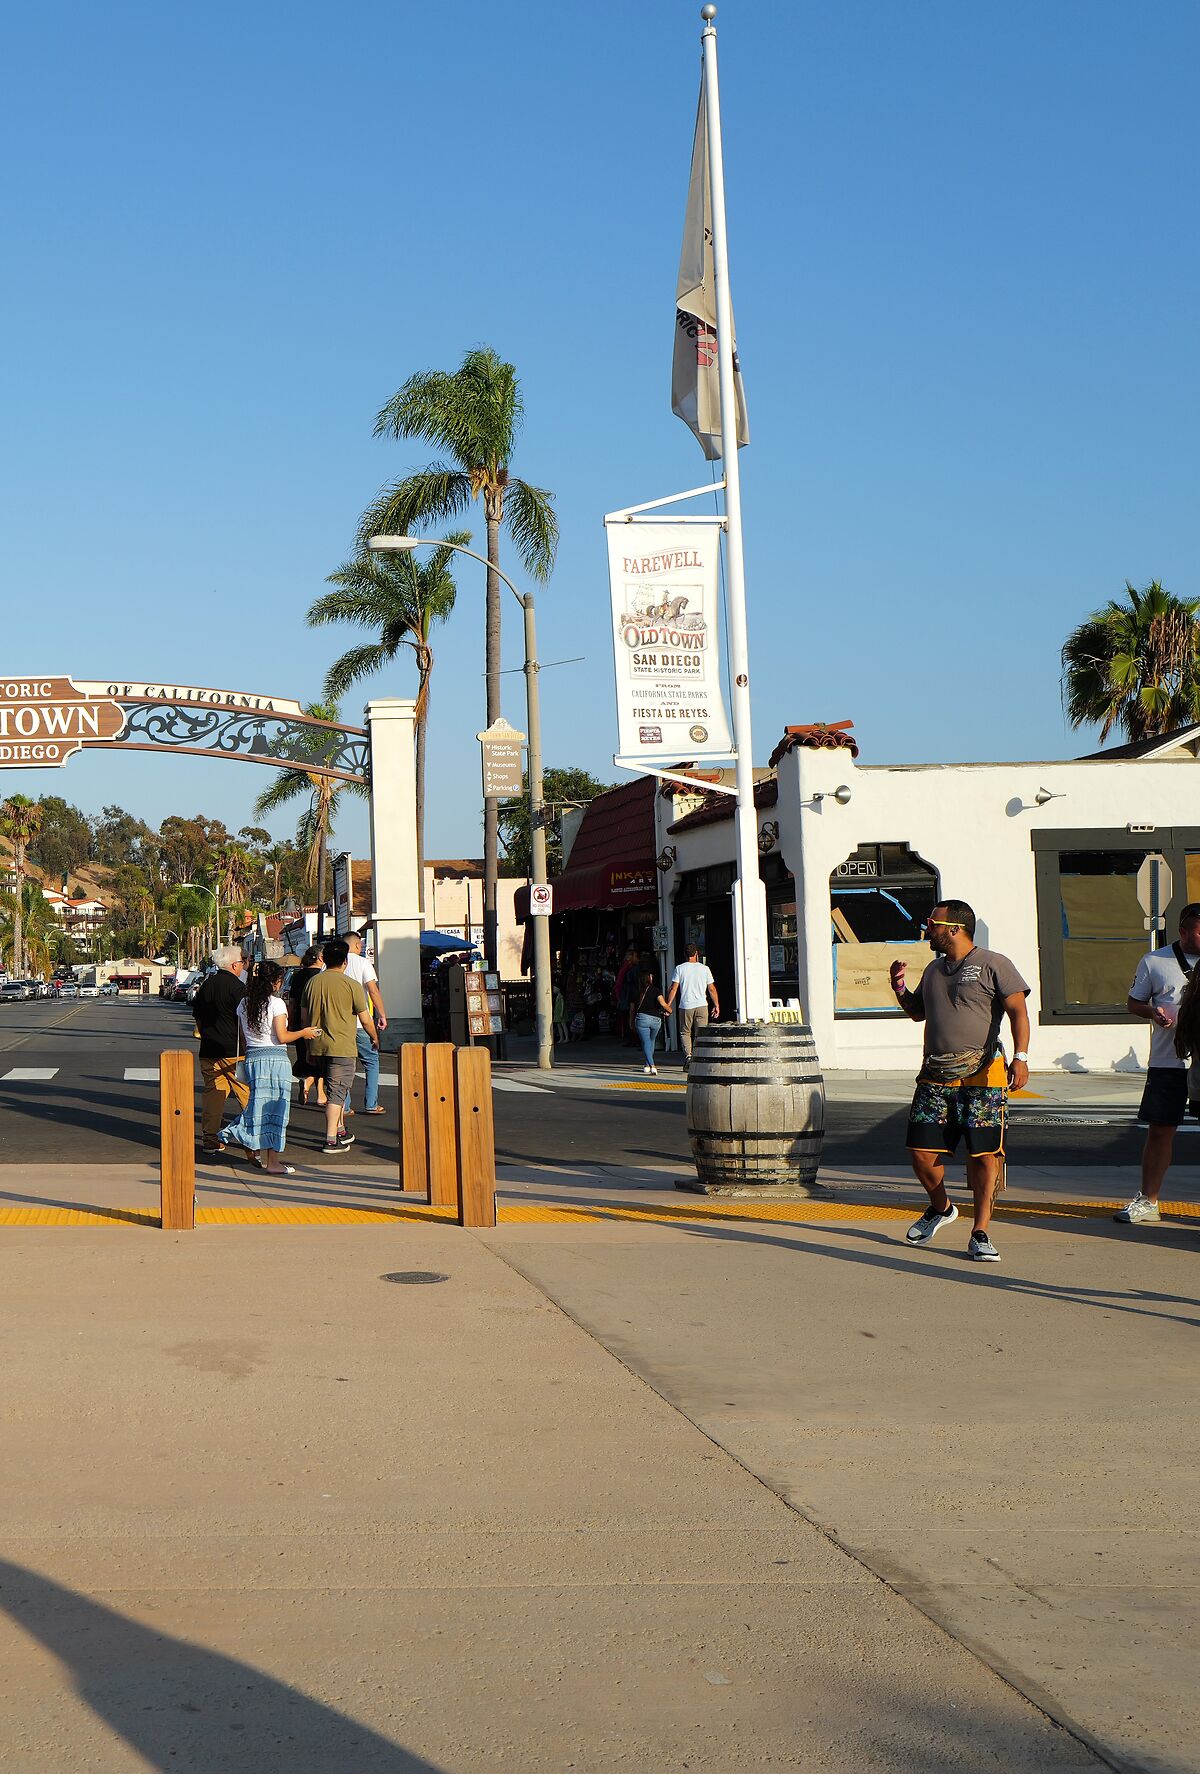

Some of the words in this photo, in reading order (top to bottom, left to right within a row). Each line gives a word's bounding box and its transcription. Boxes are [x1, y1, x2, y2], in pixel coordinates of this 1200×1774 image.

[623, 626, 659, 648] OLD
[659, 627, 705, 649] TOWN
[633, 654, 657, 665] SAN
[661, 655, 701, 667] DIEGO
[106, 684, 133, 697] OF
[144, 686, 276, 712] CALIFORNIA
[631, 690, 667, 698] CALIFORNIA
[668, 691, 687, 699] STATE
[688, 691, 708, 699] PARKS
[633, 709, 663, 718] FIESTA
[665, 709, 677, 718] DE
[0, 745, 60, 760] DIEGO
[839, 862, 876, 875] OPEN
